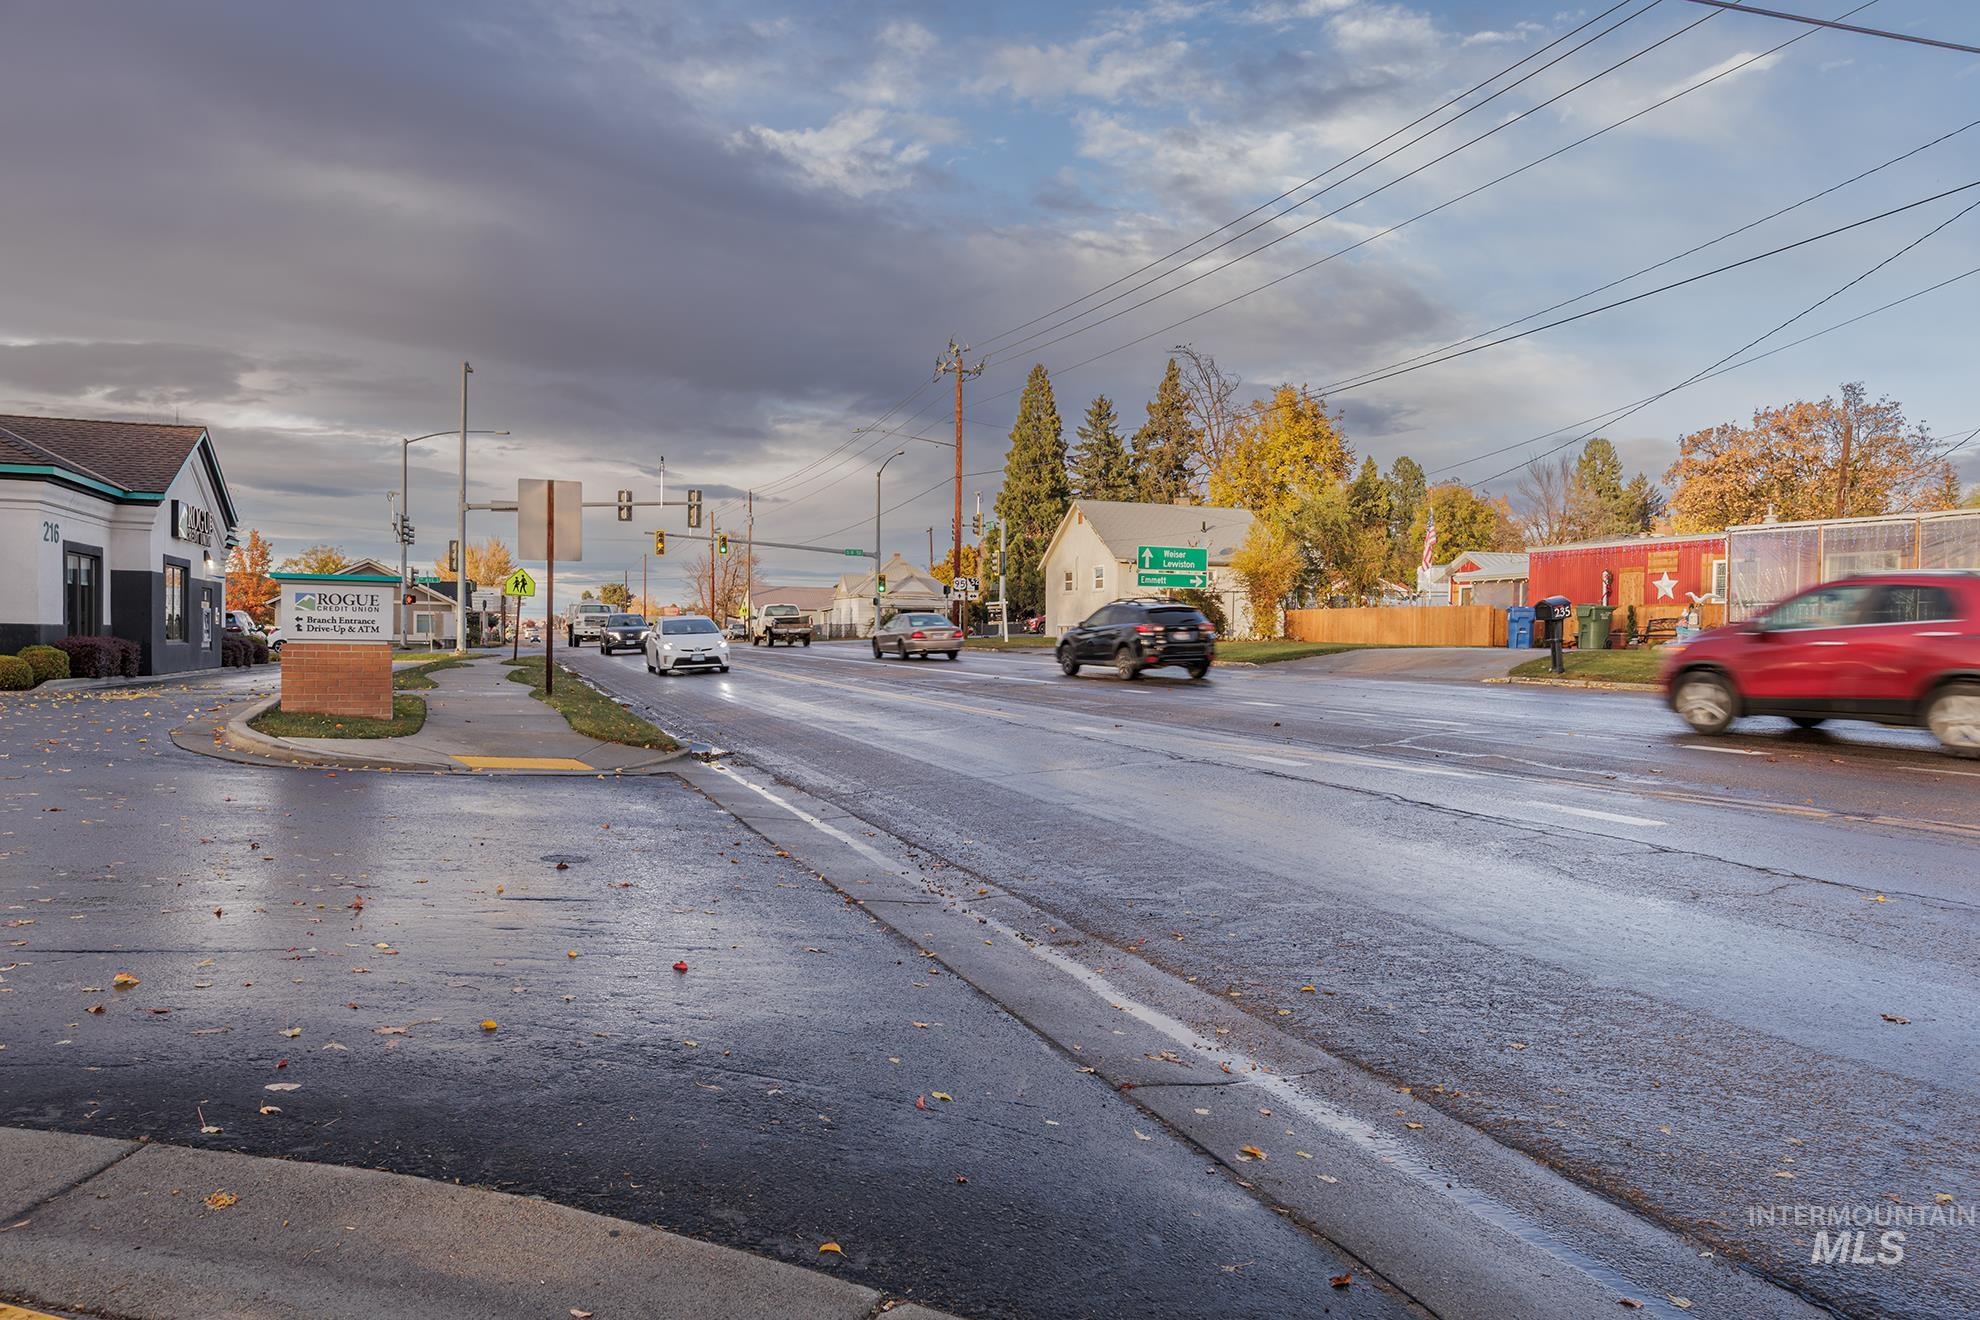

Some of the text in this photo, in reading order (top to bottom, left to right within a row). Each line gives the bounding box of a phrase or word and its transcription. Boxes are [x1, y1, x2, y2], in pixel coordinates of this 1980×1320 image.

[188, 506, 214, 534] ROGUE
[43, 521, 60, 544] 216
[1163, 550, 1186, 558] Weiser
[1162, 560, 1195, 569] Lewiston
[955, 580, 966, 588] 95
[1141, 576, 1166, 584] Emmett
[317, 593, 380, 606] ROGUE
[1555, 606, 1571, 618] 235
[306, 616, 376, 625] Branch Entrance
[306, 625, 346, 634] Drive-Up
[357, 625, 380, 633] ATM
